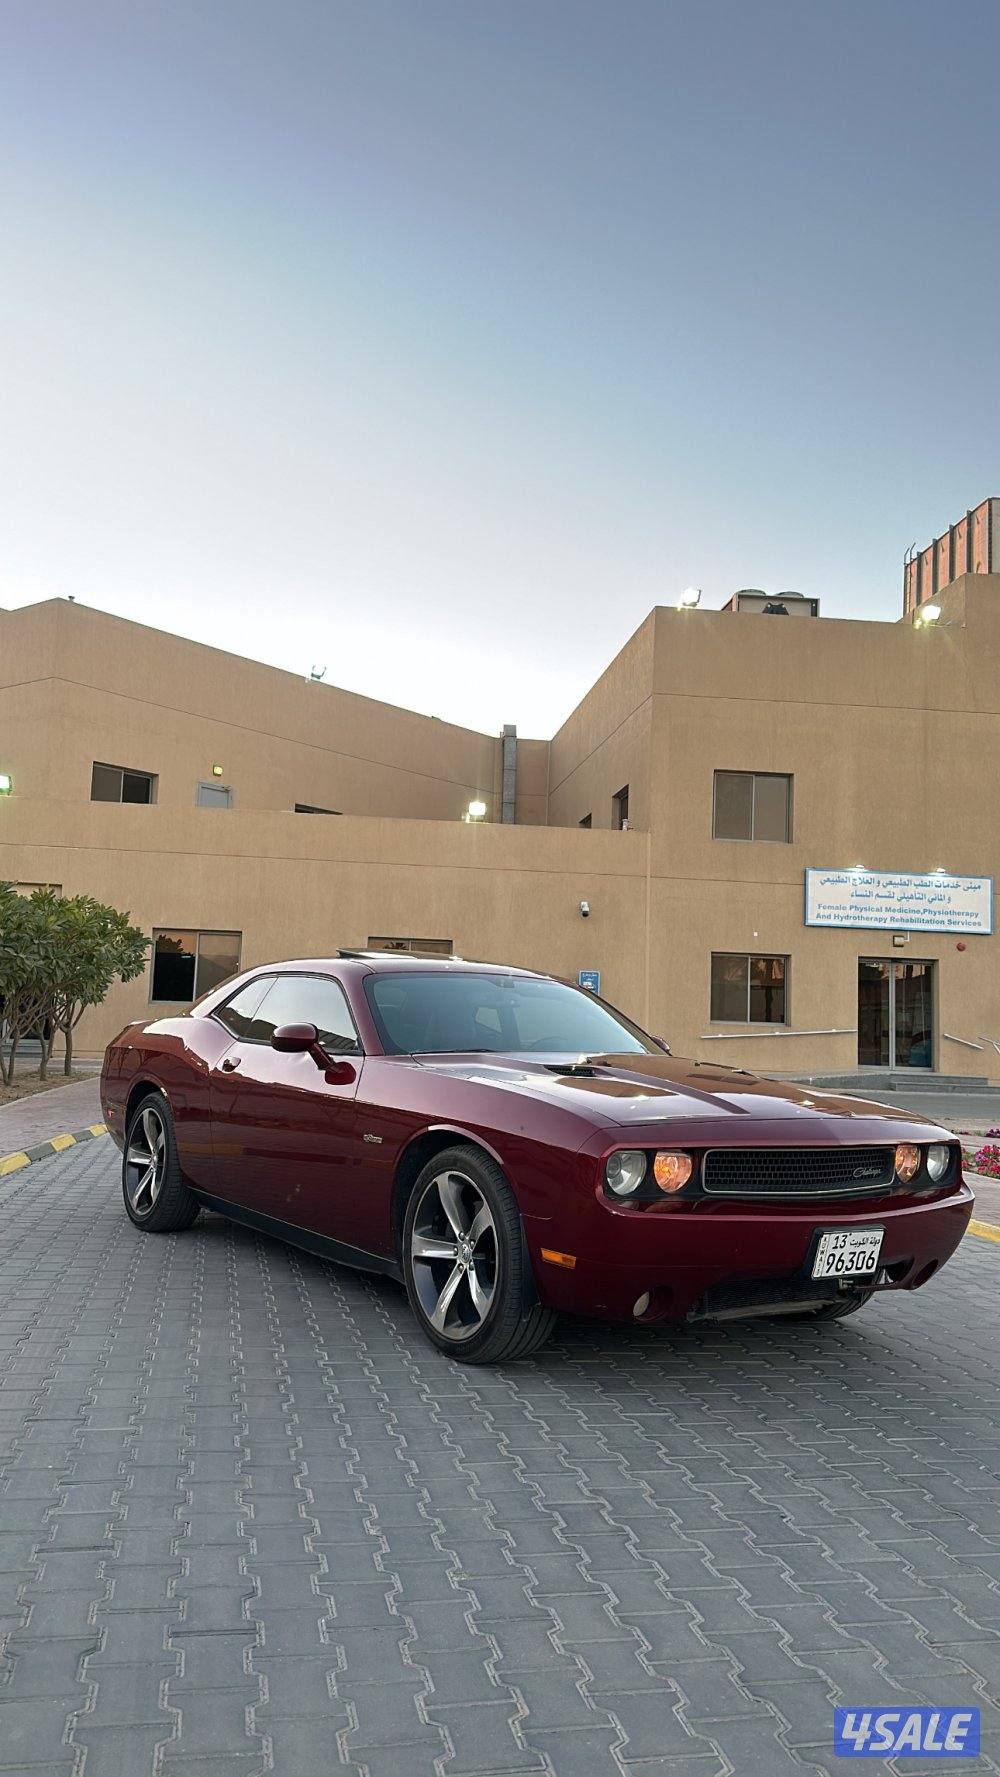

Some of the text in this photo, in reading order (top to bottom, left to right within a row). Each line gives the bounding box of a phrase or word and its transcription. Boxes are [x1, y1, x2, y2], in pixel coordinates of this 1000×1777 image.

[851, 877, 875, 886] العلاج
[876, 879, 881, 887] و
[913, 880, 934, 890] الطب
[934, 879, 961, 889] خدمات
[962, 882, 982, 893] مبنى
[850, 889, 874, 898] النساء
[874, 891, 895, 900] لقسم
[947, 896, 952, 904] و
[817, 903, 848, 911] Female
[849, 904, 883, 913] Physical
[816, 912, 982, 927] And Hydrotherapy Rehabilitation Services
[832, 1234, 848, 1249] 13
[849, 1236, 869, 1248] الكويت
[825, 1250, 876, 1274] 96306
